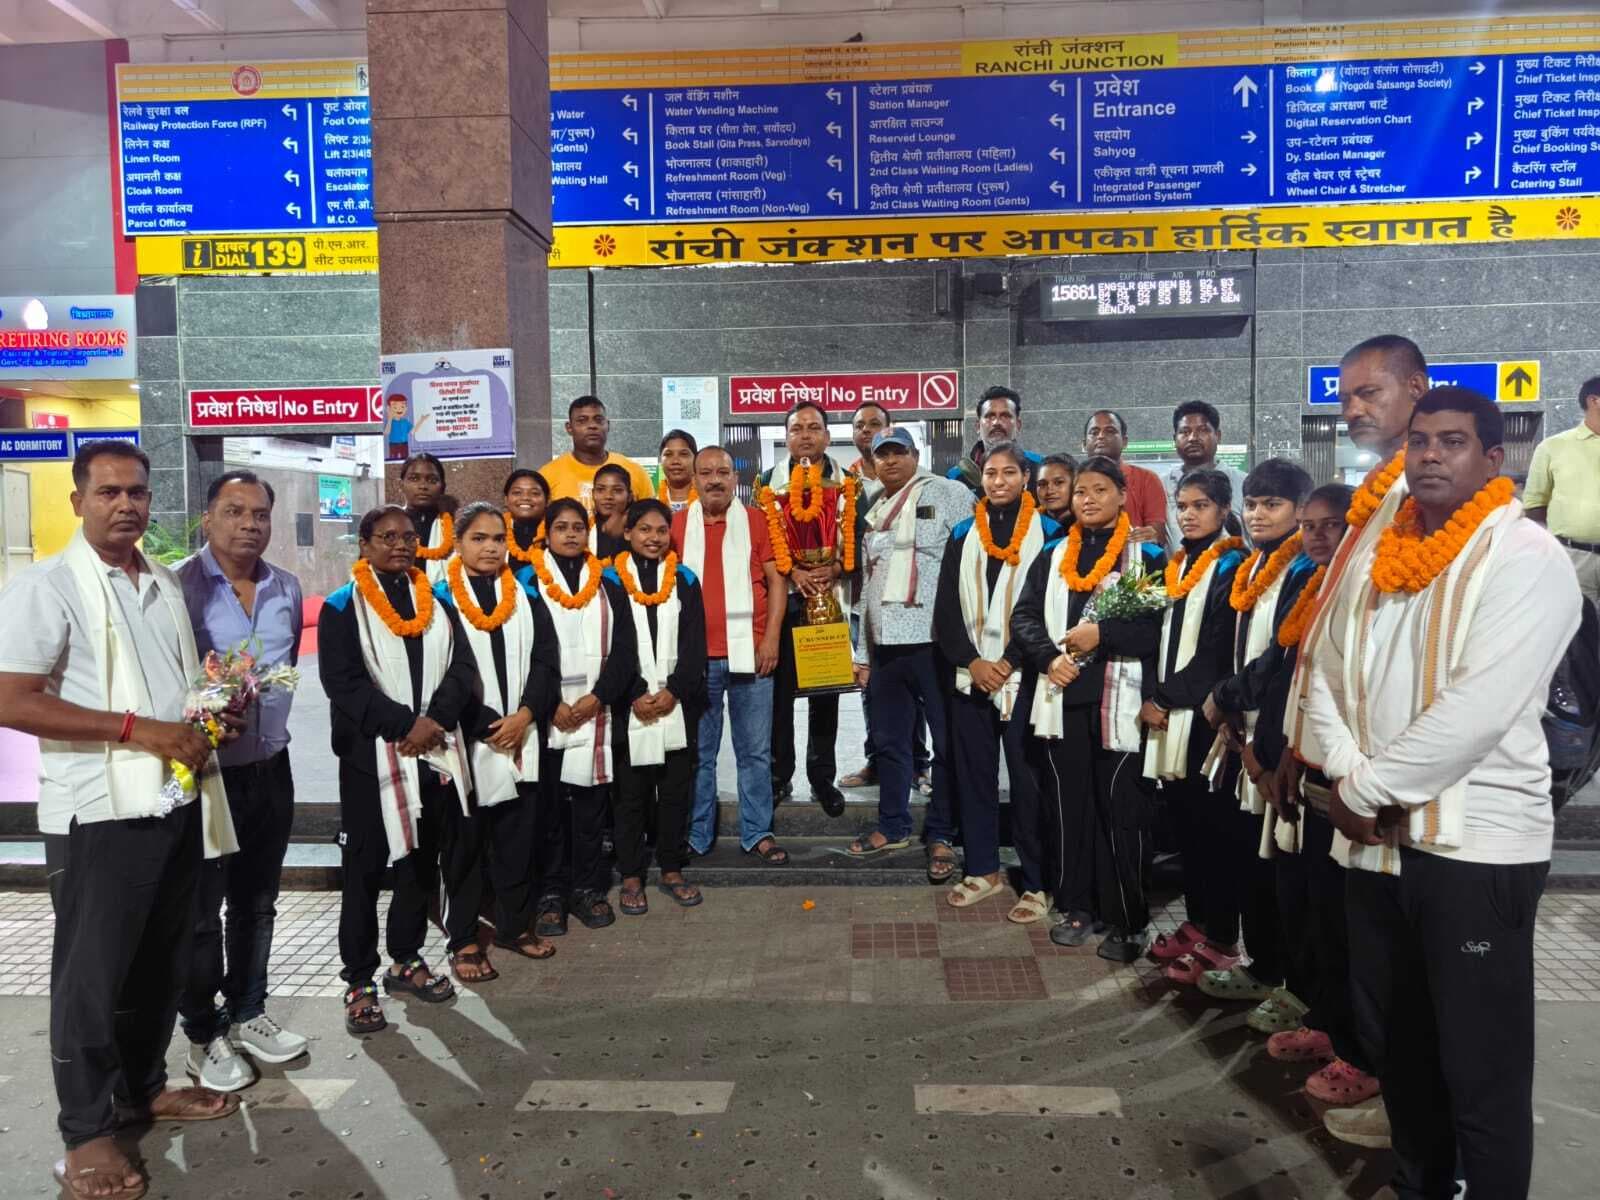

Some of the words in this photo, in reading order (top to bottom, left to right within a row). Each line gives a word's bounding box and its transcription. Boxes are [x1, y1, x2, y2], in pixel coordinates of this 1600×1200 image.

[1013, 39, 1052, 57] रांची
[1062, 38, 1125, 55] जंक्शन
[975, 59, 1053, 73] RANCHI
[1059, 54, 1164, 71] JUNCTION
[1516, 74, 1543, 84] Chief
[1545, 73, 1576, 82] Ticket
[1286, 84, 1312, 93] Book
[1377, 81, 1415, 90] Satsanga
[1418, 79, 1451, 88] Society)
[869, 101, 904, 109] Station
[907, 99, 949, 109] Manager
[1094, 102, 1176, 117] Entrance
[557, 110, 584, 119] Water
[665, 108, 693, 116] Water
[695, 106, 735, 116] Vending
[738, 105, 778, 114] Machine
[1514, 109, 1541, 119] Chief
[1544, 109, 1575, 118] Ticket
[123, 122, 159, 131] Railway
[162, 121, 209, 129] Protection
[212, 120, 238, 128] Force
[241, 119, 266, 129] (RPF)
[323, 117, 344, 125] Foot
[347, 116, 372, 126] Over
[1286, 118, 1318, 129] Digital
[1321, 116, 1381, 126] Reservation
[1384, 115, 1411, 124] Chart
[869, 133, 915, 143] Reserved
[919, 133, 955, 142] Lounge
[665, 140, 690, 149] Book
[693, 140, 714, 149] Stall
[717, 139, 736, 149] (Gita
[1513, 144, 1540, 153] Chief
[1543, 143, 1587, 152] Booking
[325, 150, 340, 159] Lift
[1094, 147, 1135, 157] Sahyog
[1286, 153, 1301, 163] Dy.
[1304, 151, 1339, 161] Station
[1343, 151, 1385, 160] Manager
[125, 155, 150, 163] Linen
[153, 154, 180, 162] Room
[870, 168, 888, 176] 2nd
[891, 167, 918, 175] Class
[921, 166, 958, 175] Waiting
[961, 165, 991, 173] Room
[994, 163, 1033, 173] (Ladies)
[551, 176, 586, 186] Waiting
[590, 176, 607, 184] Hall
[666, 173, 727, 182] Refreshment
[730, 172, 758, 180] Room
[761, 171, 786, 181] (Veg)
[326, 183, 369, 191] Escalator
[1094, 182, 1144, 192] Integrated
[1147, 182, 1201, 191] Passenger
[1511, 179, 1555, 188] Catering
[1559, 178, 1582, 187] Stall
[127, 187, 152, 195] Cloak
[155, 186, 182, 194] Room
[1287, 187, 1317, 196] Wheel
[1320, 186, 1347, 195] Chair
[1350, 185, 1357, 193] &
[1360, 184, 1406, 193] Stretcher
[1094, 193, 1151, 202] Information
[1154, 192, 1191, 201] System
[871, 201, 888, 209] 2nd
[892, 200, 919, 209] Class
[922, 199, 959, 208] Waiting
[962, 198, 991, 206] Room
[994, 197, 1029, 207] (Gents)
[666, 206, 728, 215] Refreshment
[730, 205, 759, 214] Room
[762, 203, 809, 214] (Non-Veg)
[128, 219, 156, 227] Parcel
[159, 219, 186, 227] Office
[649, 227, 744, 260] रांची
[759, 227, 919, 258] जंक्शन
[930, 230, 986, 253] पर
[1002, 225, 1158, 251] आपका
[1171, 213, 1309, 248] हार्दिक
[1324, 215, 1471, 242] स्वागत
[1488, 205, 1516, 238] है
[216, 254, 250, 266] DIAL
[251, 240, 303, 266] 139
[1051, 284, 1097, 302] 15661
[0, 331, 70, 348] RETIRING
[76, 330, 128, 347] ROOMS
[738, 382, 777, 405] प्रवेश
[780, 380, 824, 403] निषेध
[831, 387, 856, 402] No
[861, 386, 910, 403] Entry
[196, 396, 234, 418] प्रवेश
[236, 394, 278, 417] निषेध
[284, 400, 310, 416] No
[313, 399, 359, 418] Entry
[1, 441, 13, 451] AC
[14, 440, 63, 451] DORMITORY
